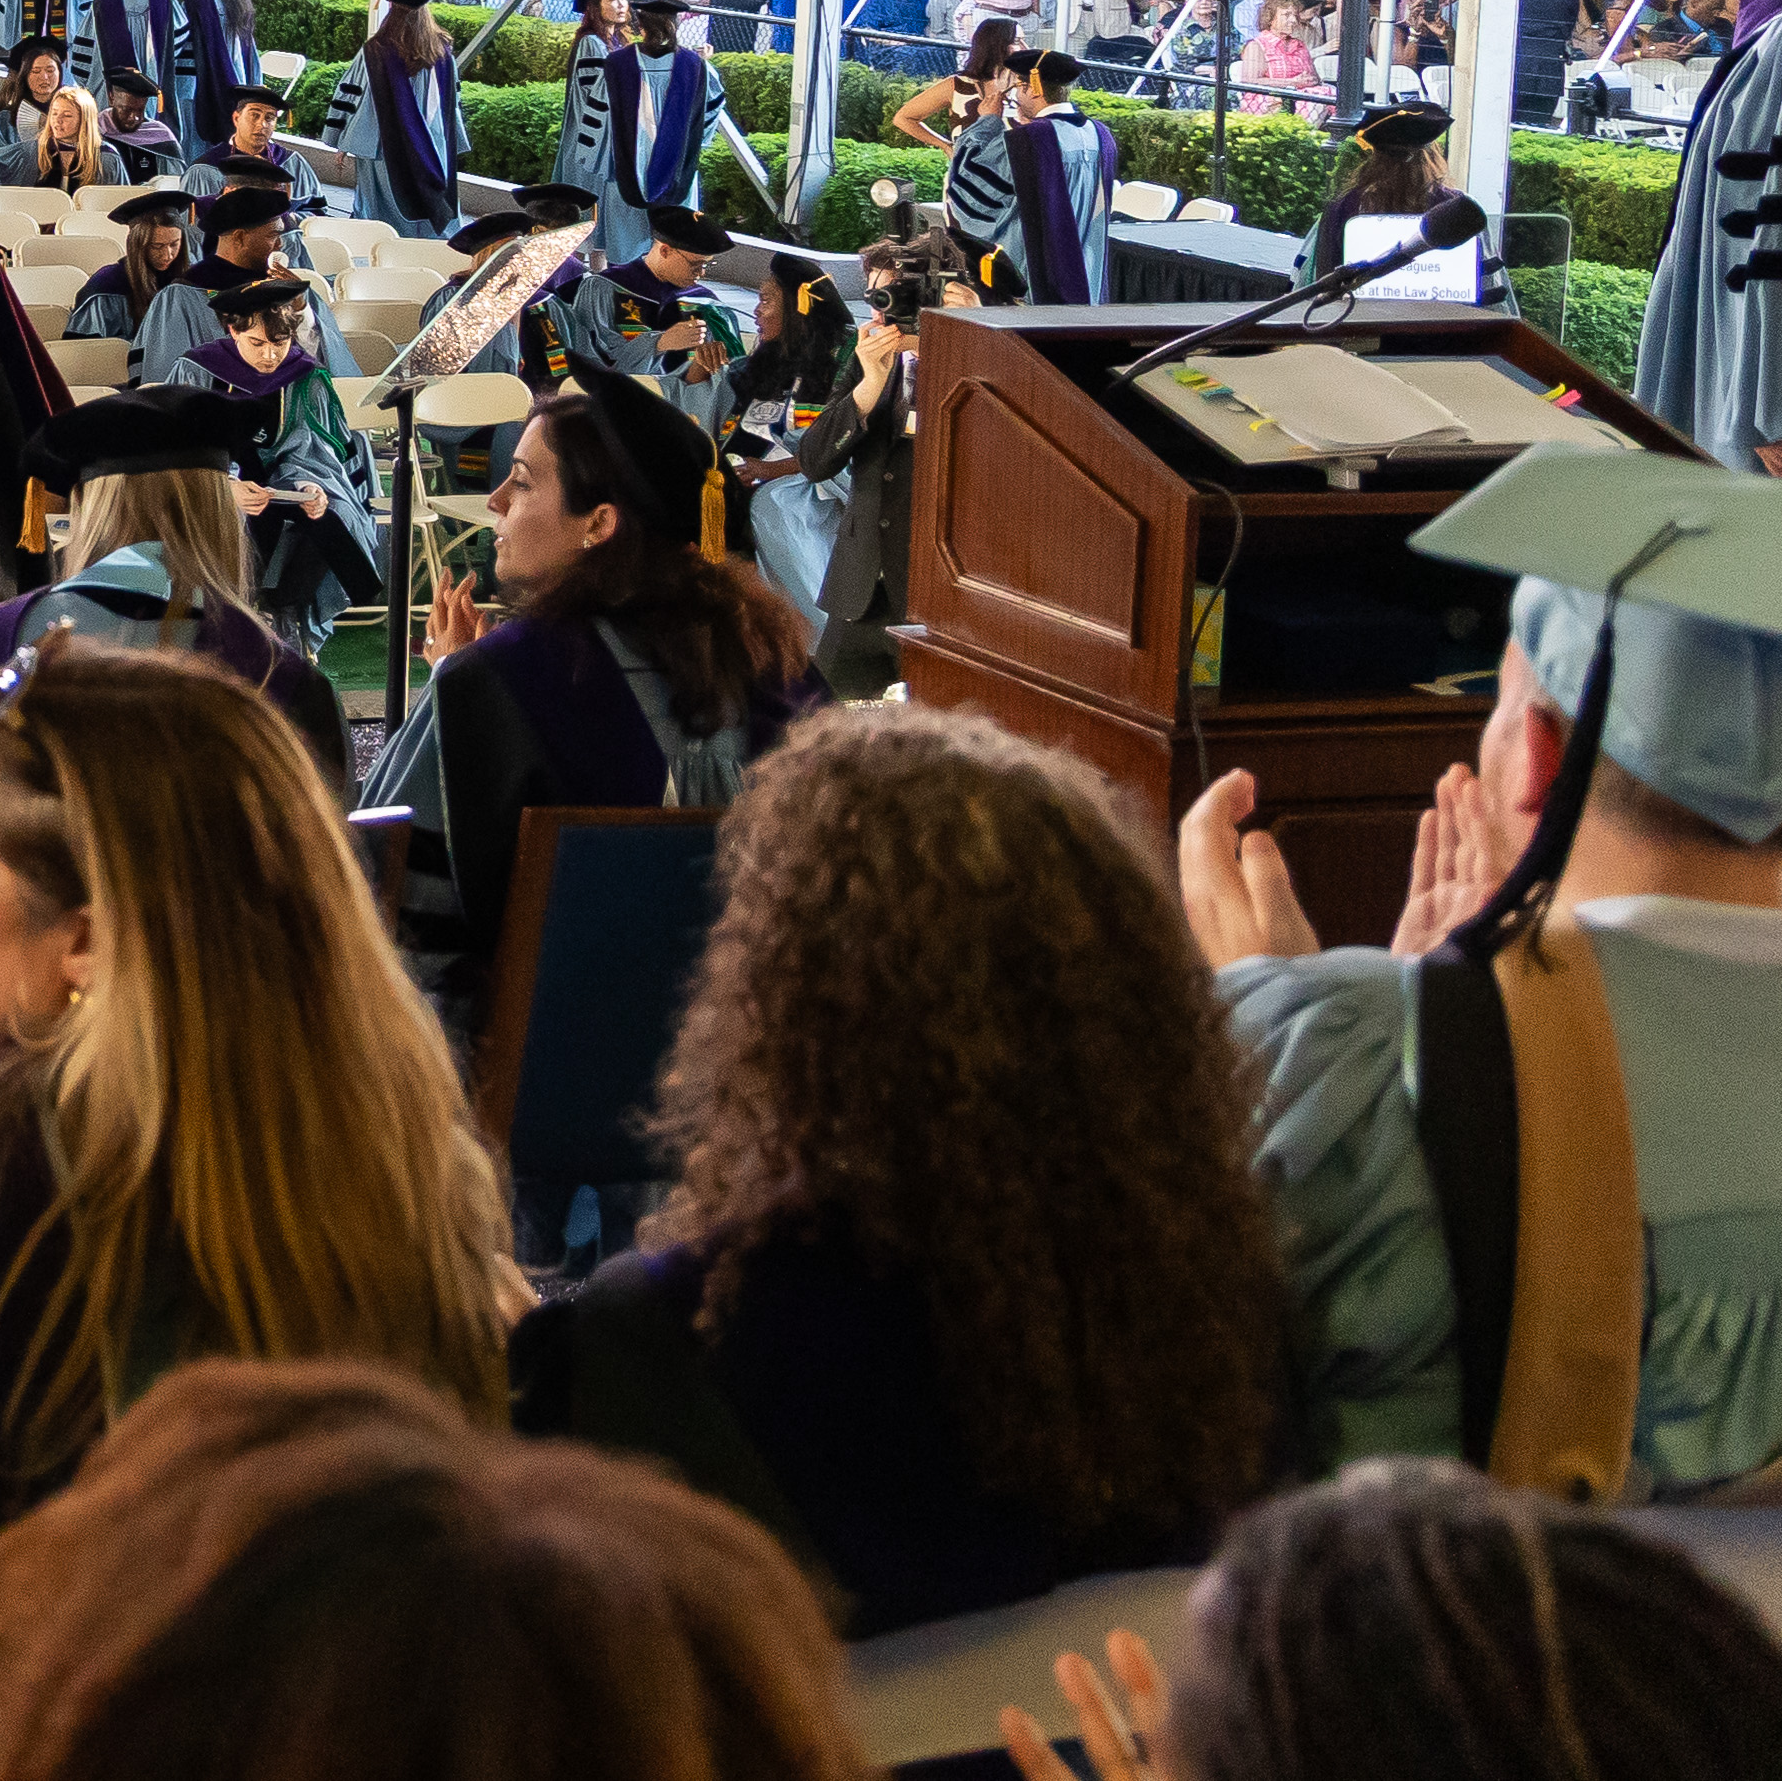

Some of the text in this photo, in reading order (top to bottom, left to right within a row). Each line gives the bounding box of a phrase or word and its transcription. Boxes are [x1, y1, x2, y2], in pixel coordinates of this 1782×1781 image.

[1400, 261, 1441, 275] agues
[1368, 286, 1379, 297] at
[1383, 286, 1401, 297] the
[1404, 286, 1428, 298] Law
[1431, 286, 1471, 300] School
